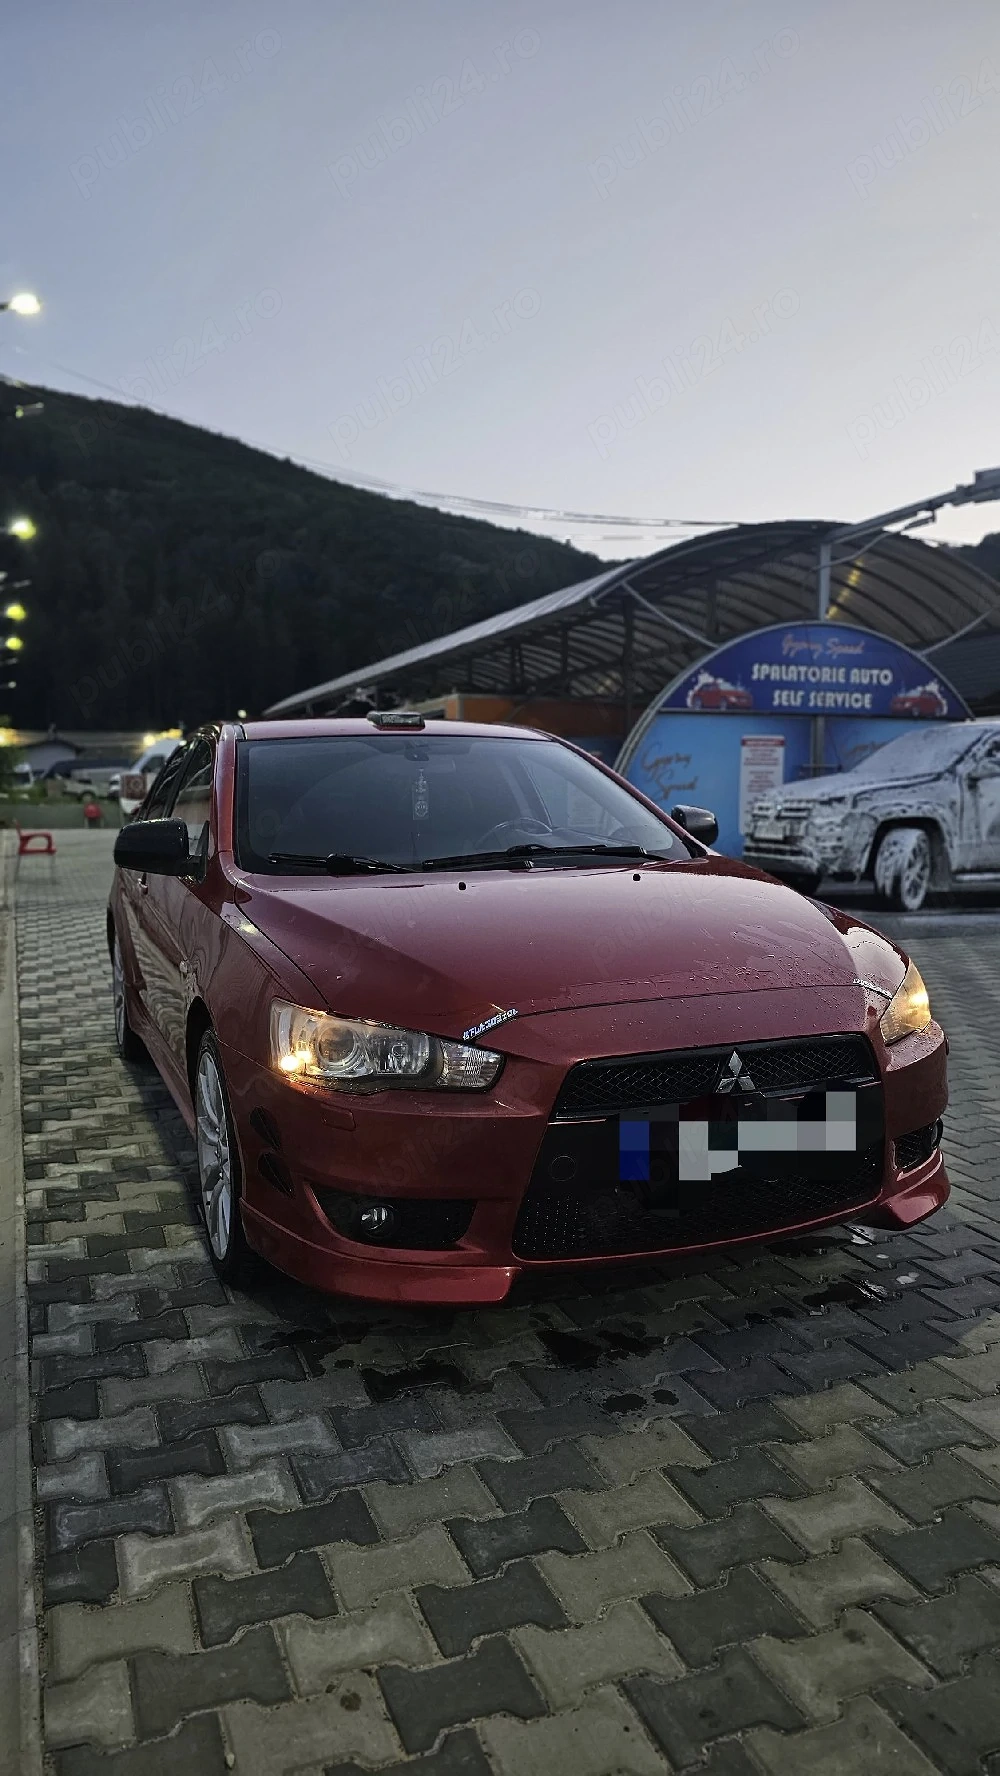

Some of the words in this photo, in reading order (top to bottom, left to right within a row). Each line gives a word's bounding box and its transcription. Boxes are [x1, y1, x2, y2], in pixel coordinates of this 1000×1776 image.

[752, 663, 846, 683] SPALATORIE
[850, 668, 893, 686] AUTO
[773, 689, 805, 707] SELF
[808, 691, 872, 709] SERVICE
